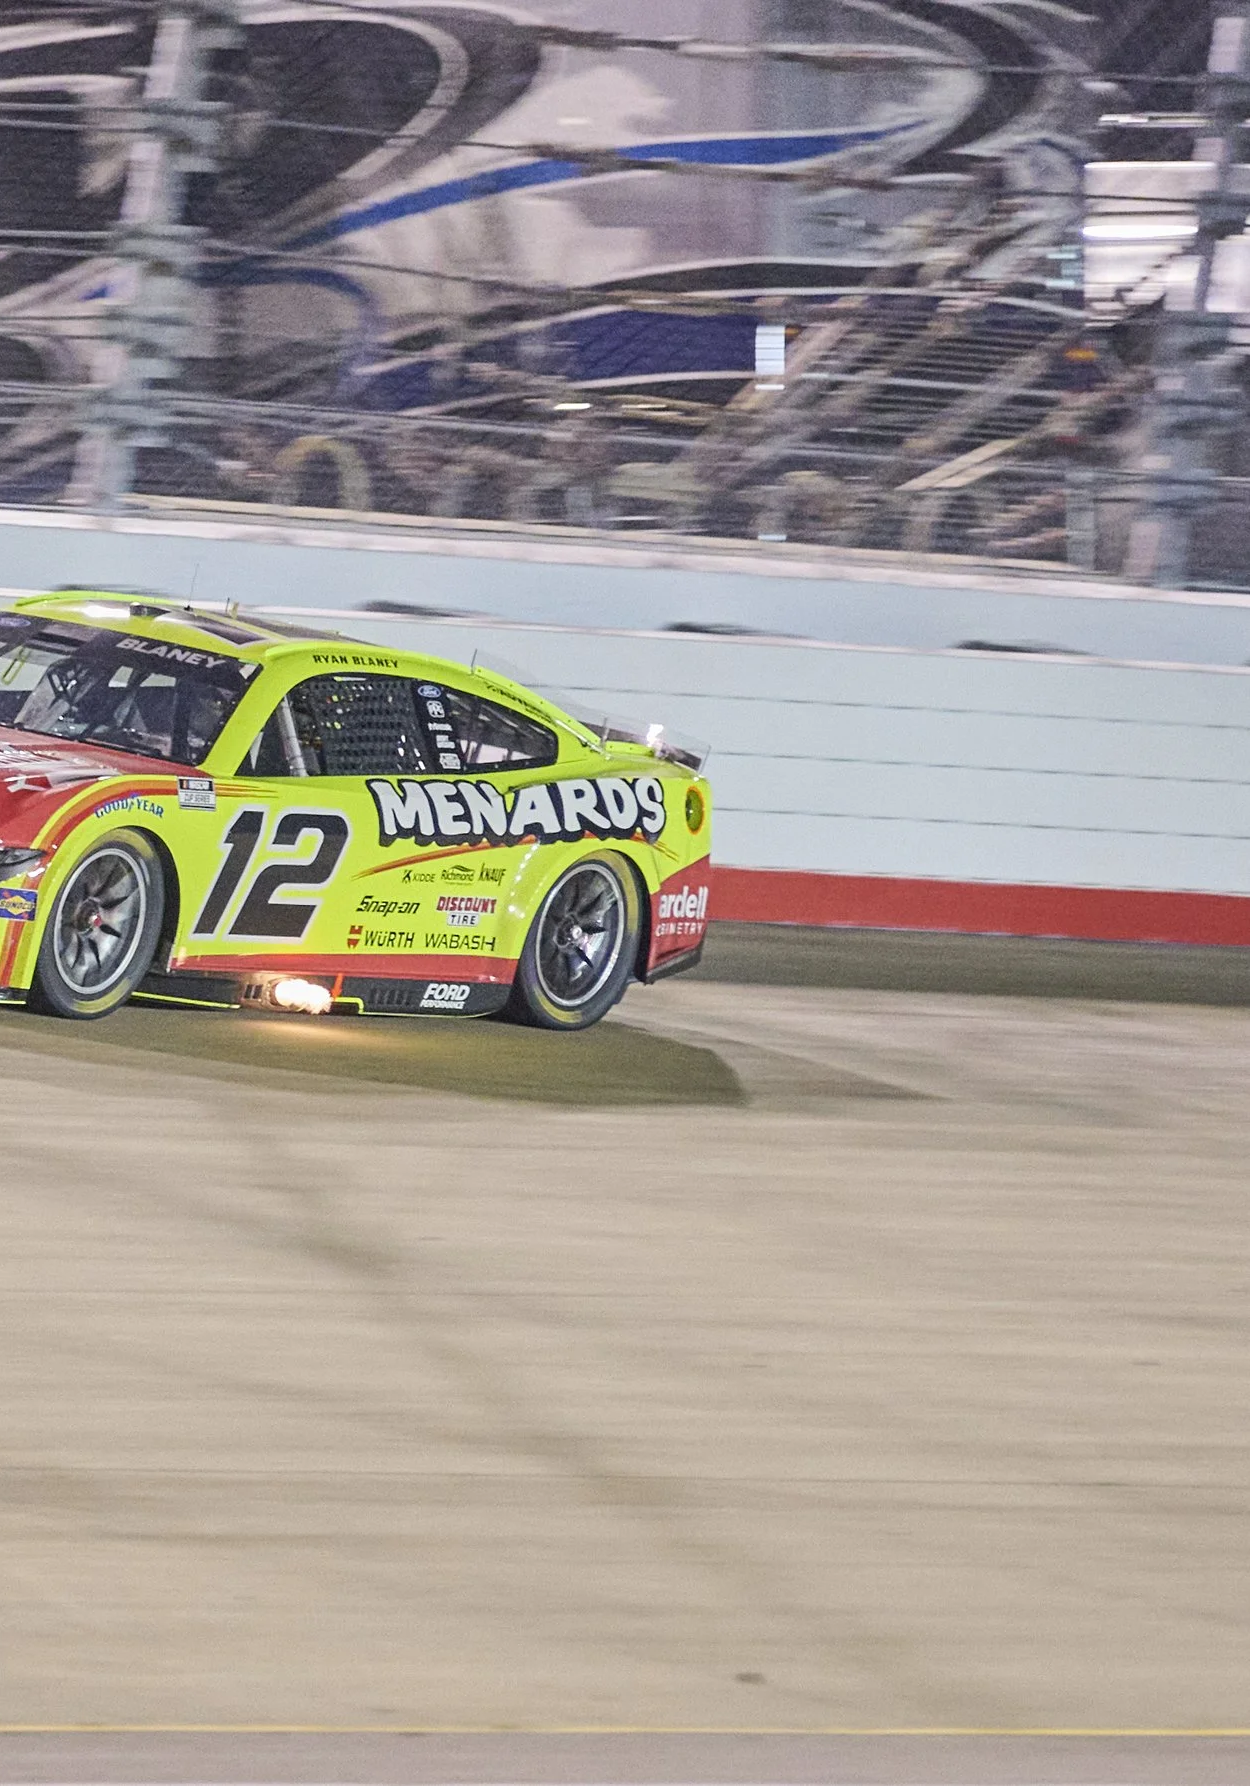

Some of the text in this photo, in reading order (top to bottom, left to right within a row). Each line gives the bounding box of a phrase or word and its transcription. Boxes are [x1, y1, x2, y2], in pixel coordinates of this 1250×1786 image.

[116, 638, 226, 668] BLANEY
[313, 655, 398, 668] RYAN BLANEY
[370, 777, 665, 843] MENARDS
[192, 808, 350, 940] 12
[441, 869, 474, 882] Richmond
[478, 862, 506, 886] KNAUF
[356, 895, 420, 917] Snap-on
[436, 896, 497, 914] DISCOUNT
[450, 914, 477, 925] TIRE
[425, 933, 496, 951] WABASH
[423, 983, 470, 1001] FORD
